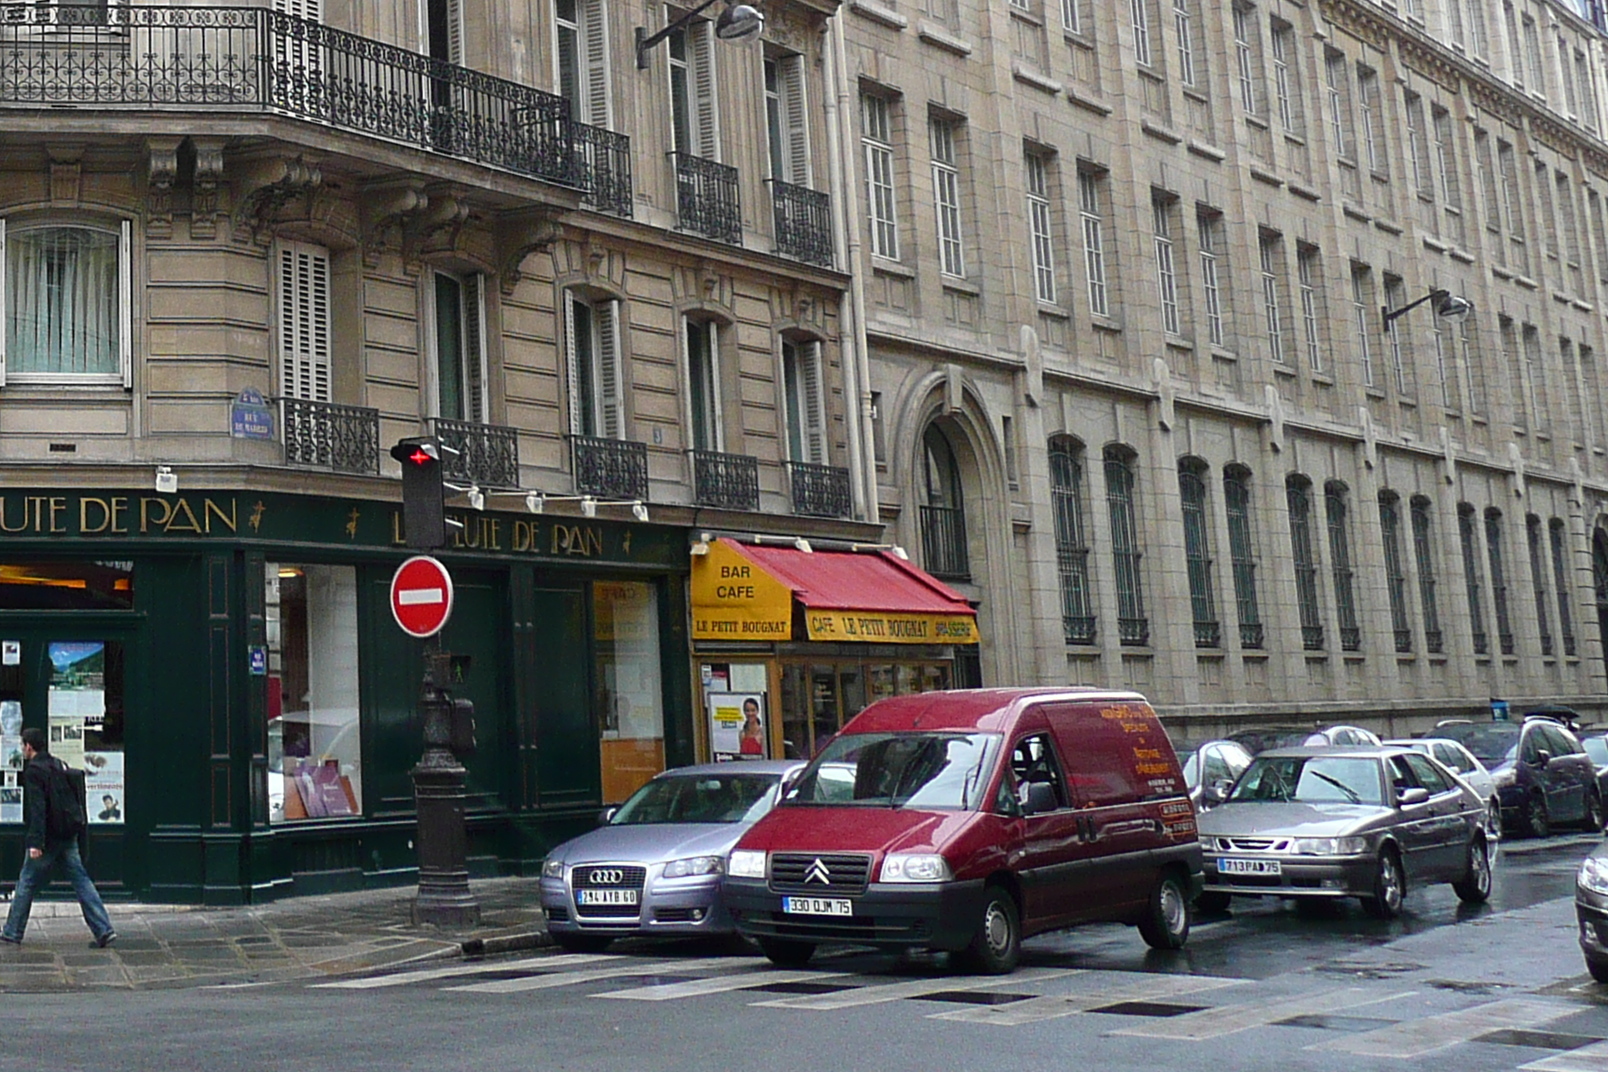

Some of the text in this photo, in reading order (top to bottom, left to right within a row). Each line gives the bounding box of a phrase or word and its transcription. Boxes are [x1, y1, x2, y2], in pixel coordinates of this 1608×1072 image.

[80, 497, 128, 533] DE
[140, 498, 236, 534] PAN
[513, 521, 540, 553] DE
[551, 524, 603, 556] PAN
[721, 566, 750, 579] BAR
[717, 586, 754, 599] CAFE
[696, 620, 787, 633] LE PETIT BOUGNAT
[812, 617, 835, 633] CAFE
[842, 617, 857, 634] LE
[858, 618, 886, 636] PETIT
[887, 619, 928, 637] BOUGNAT
[790, 899, 810, 912] 330
[836, 901, 850, 914] 75
